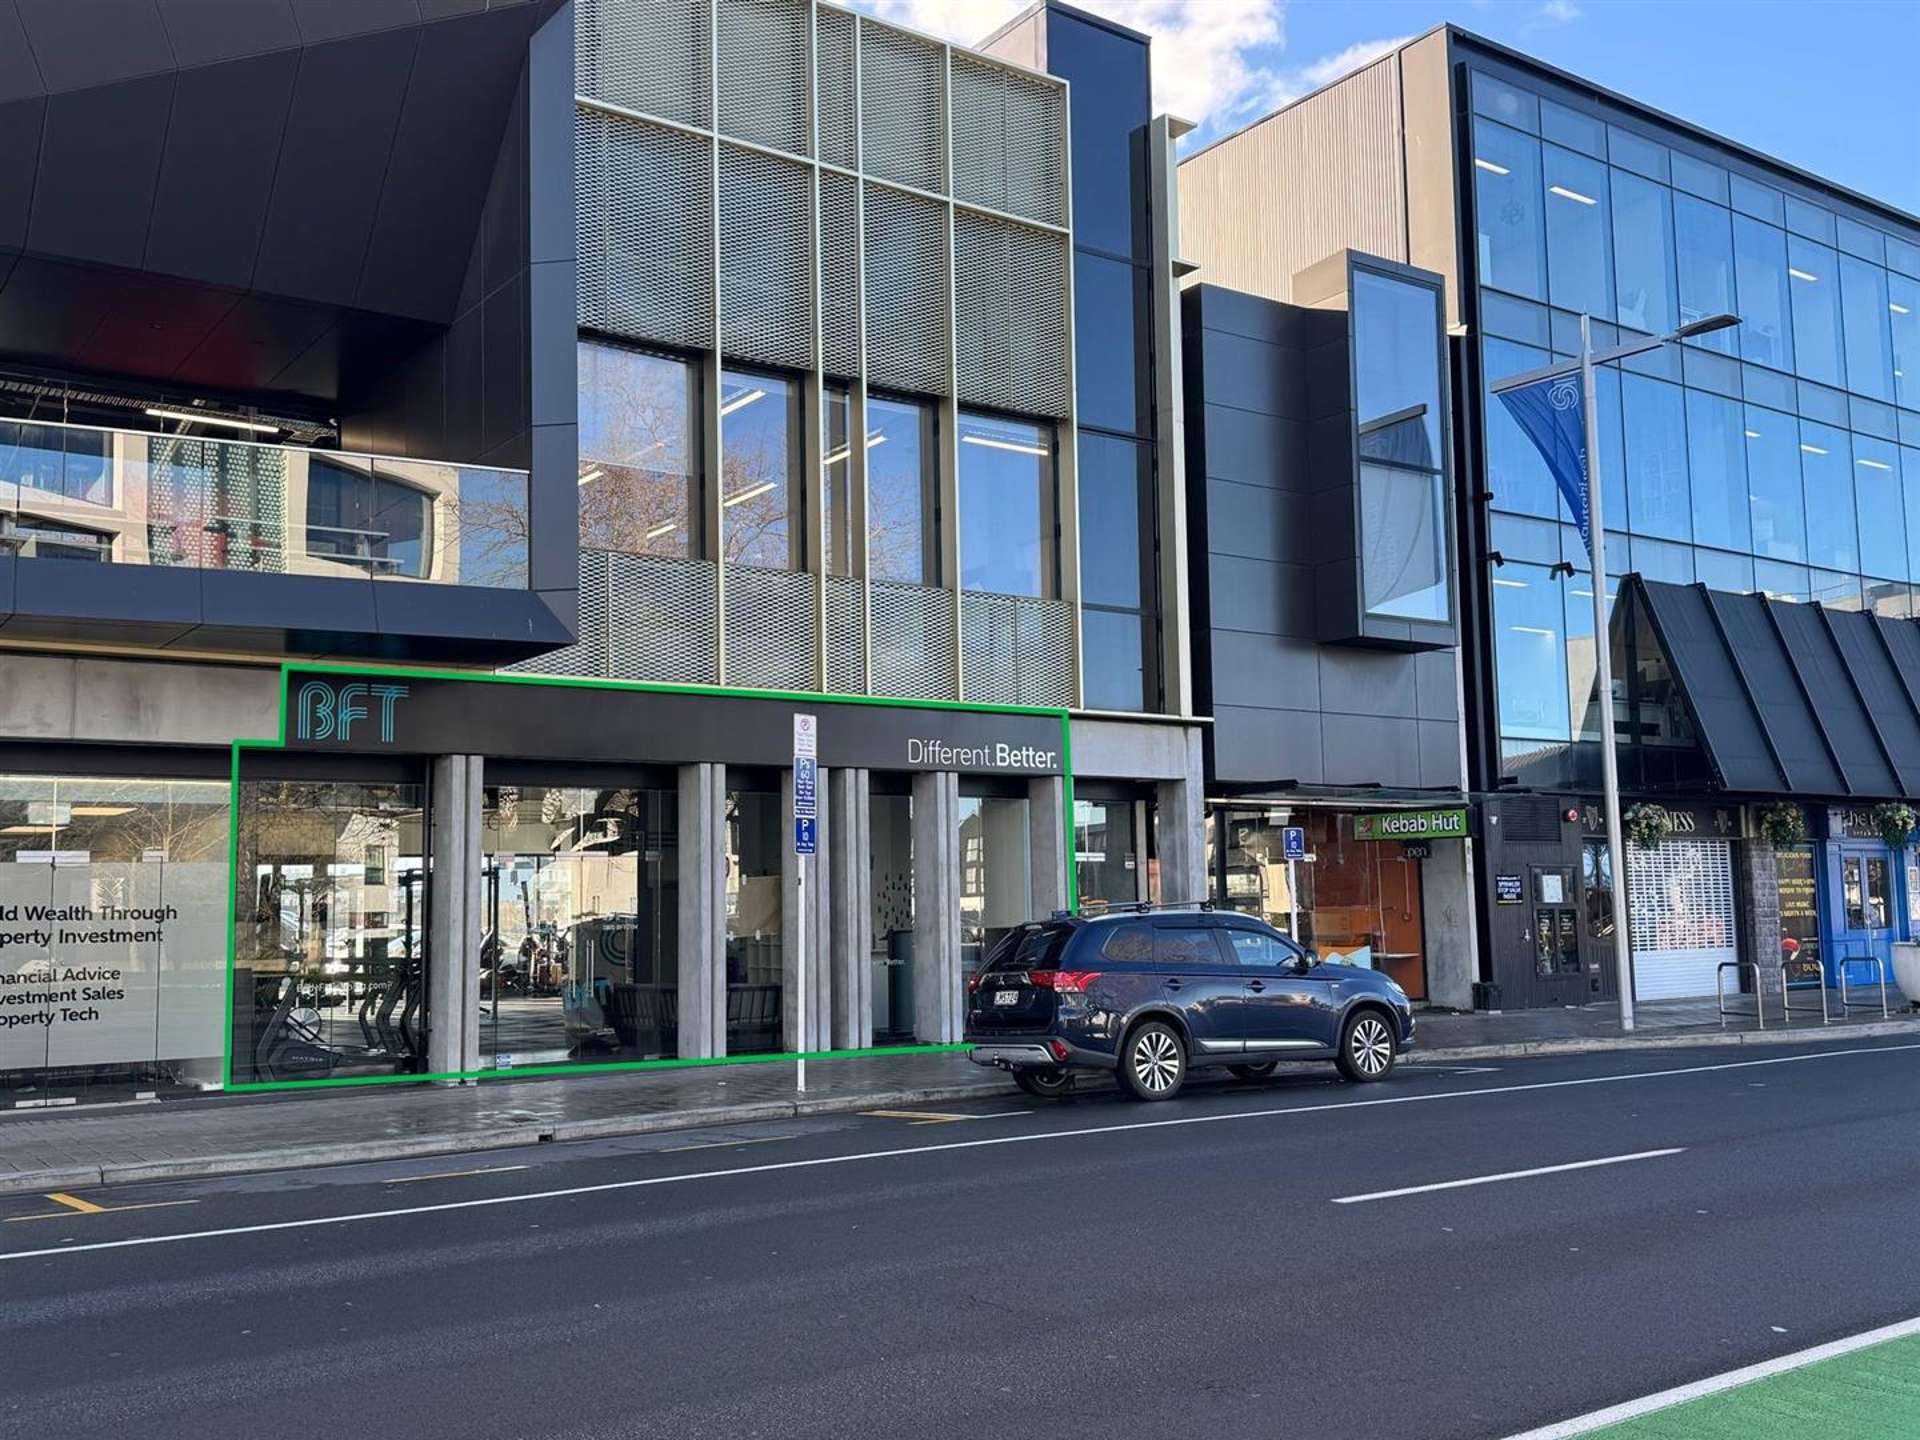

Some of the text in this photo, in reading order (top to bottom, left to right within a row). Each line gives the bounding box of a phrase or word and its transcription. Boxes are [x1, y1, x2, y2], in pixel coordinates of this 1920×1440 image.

[298, 681, 409, 743] BFT
[802, 819, 809, 831] P
[1382, 813, 1460, 833] Kebab Hut
[1290, 830, 1297, 840] P
[25, 905, 93, 921] Wealth
[100, 904, 178, 924] Through
[59, 928, 163, 944] Investment
[62, 966, 121, 982] Advice
[82, 987, 125, 1001] Sales
[60, 1007, 99, 1022] Tech
